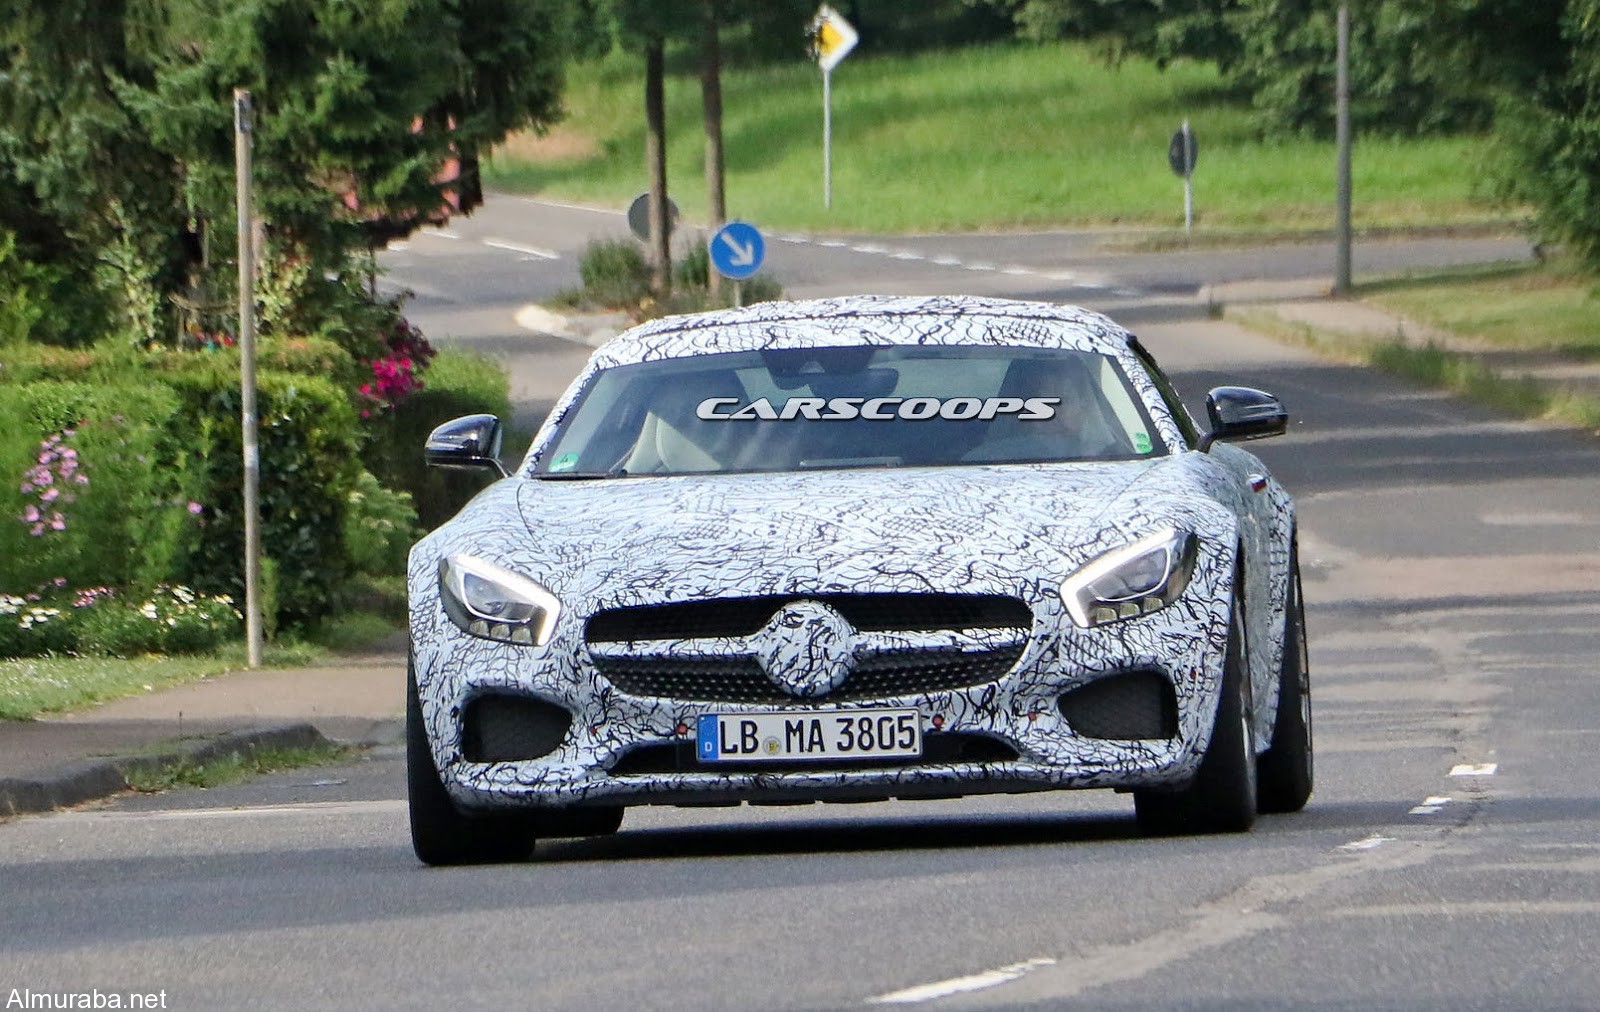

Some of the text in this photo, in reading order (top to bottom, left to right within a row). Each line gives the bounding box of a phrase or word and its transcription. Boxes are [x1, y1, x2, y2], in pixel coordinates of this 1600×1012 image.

[704, 715, 916, 754] D LB MA 3805
